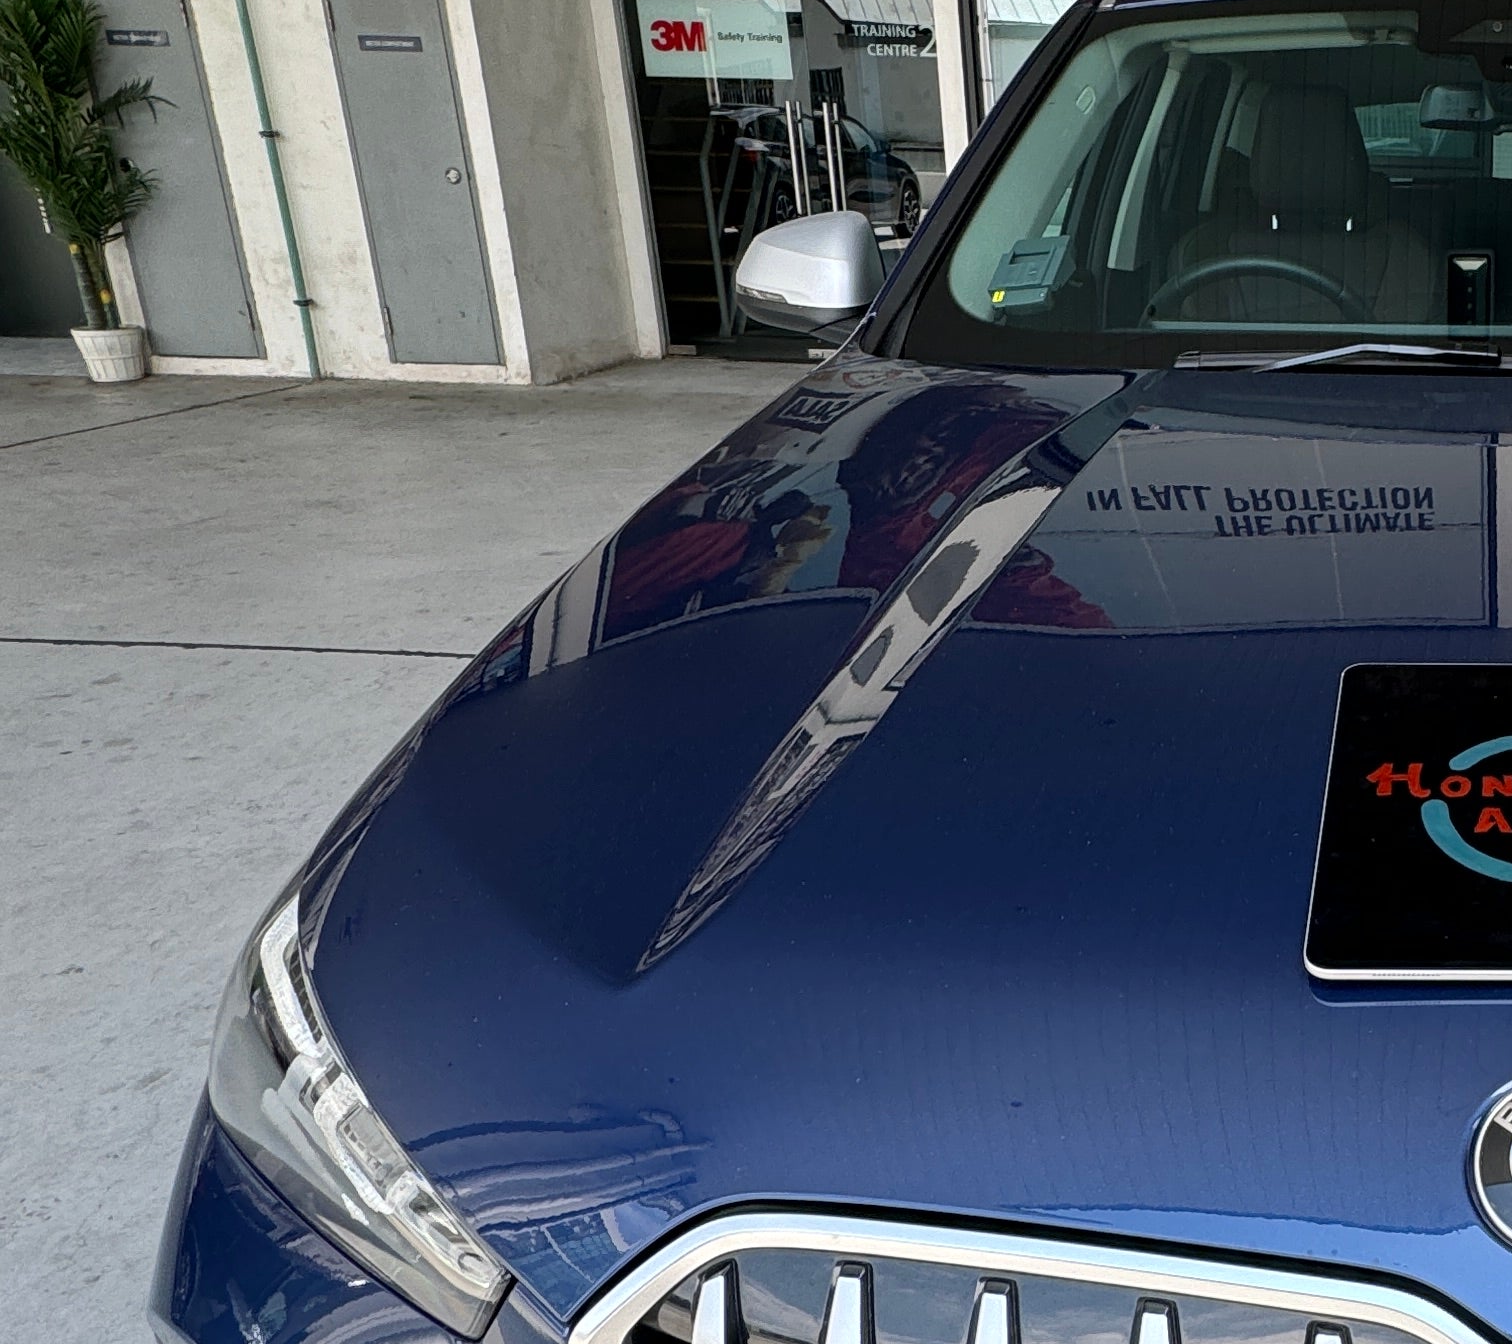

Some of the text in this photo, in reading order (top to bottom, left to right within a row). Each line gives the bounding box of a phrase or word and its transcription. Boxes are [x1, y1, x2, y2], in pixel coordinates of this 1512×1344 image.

[650, 19, 707, 52] 3M
[717, 31, 783, 44] Safety Training
[851, 23, 916, 38] TRAINING
[867, 43, 918, 57] CENTRE
